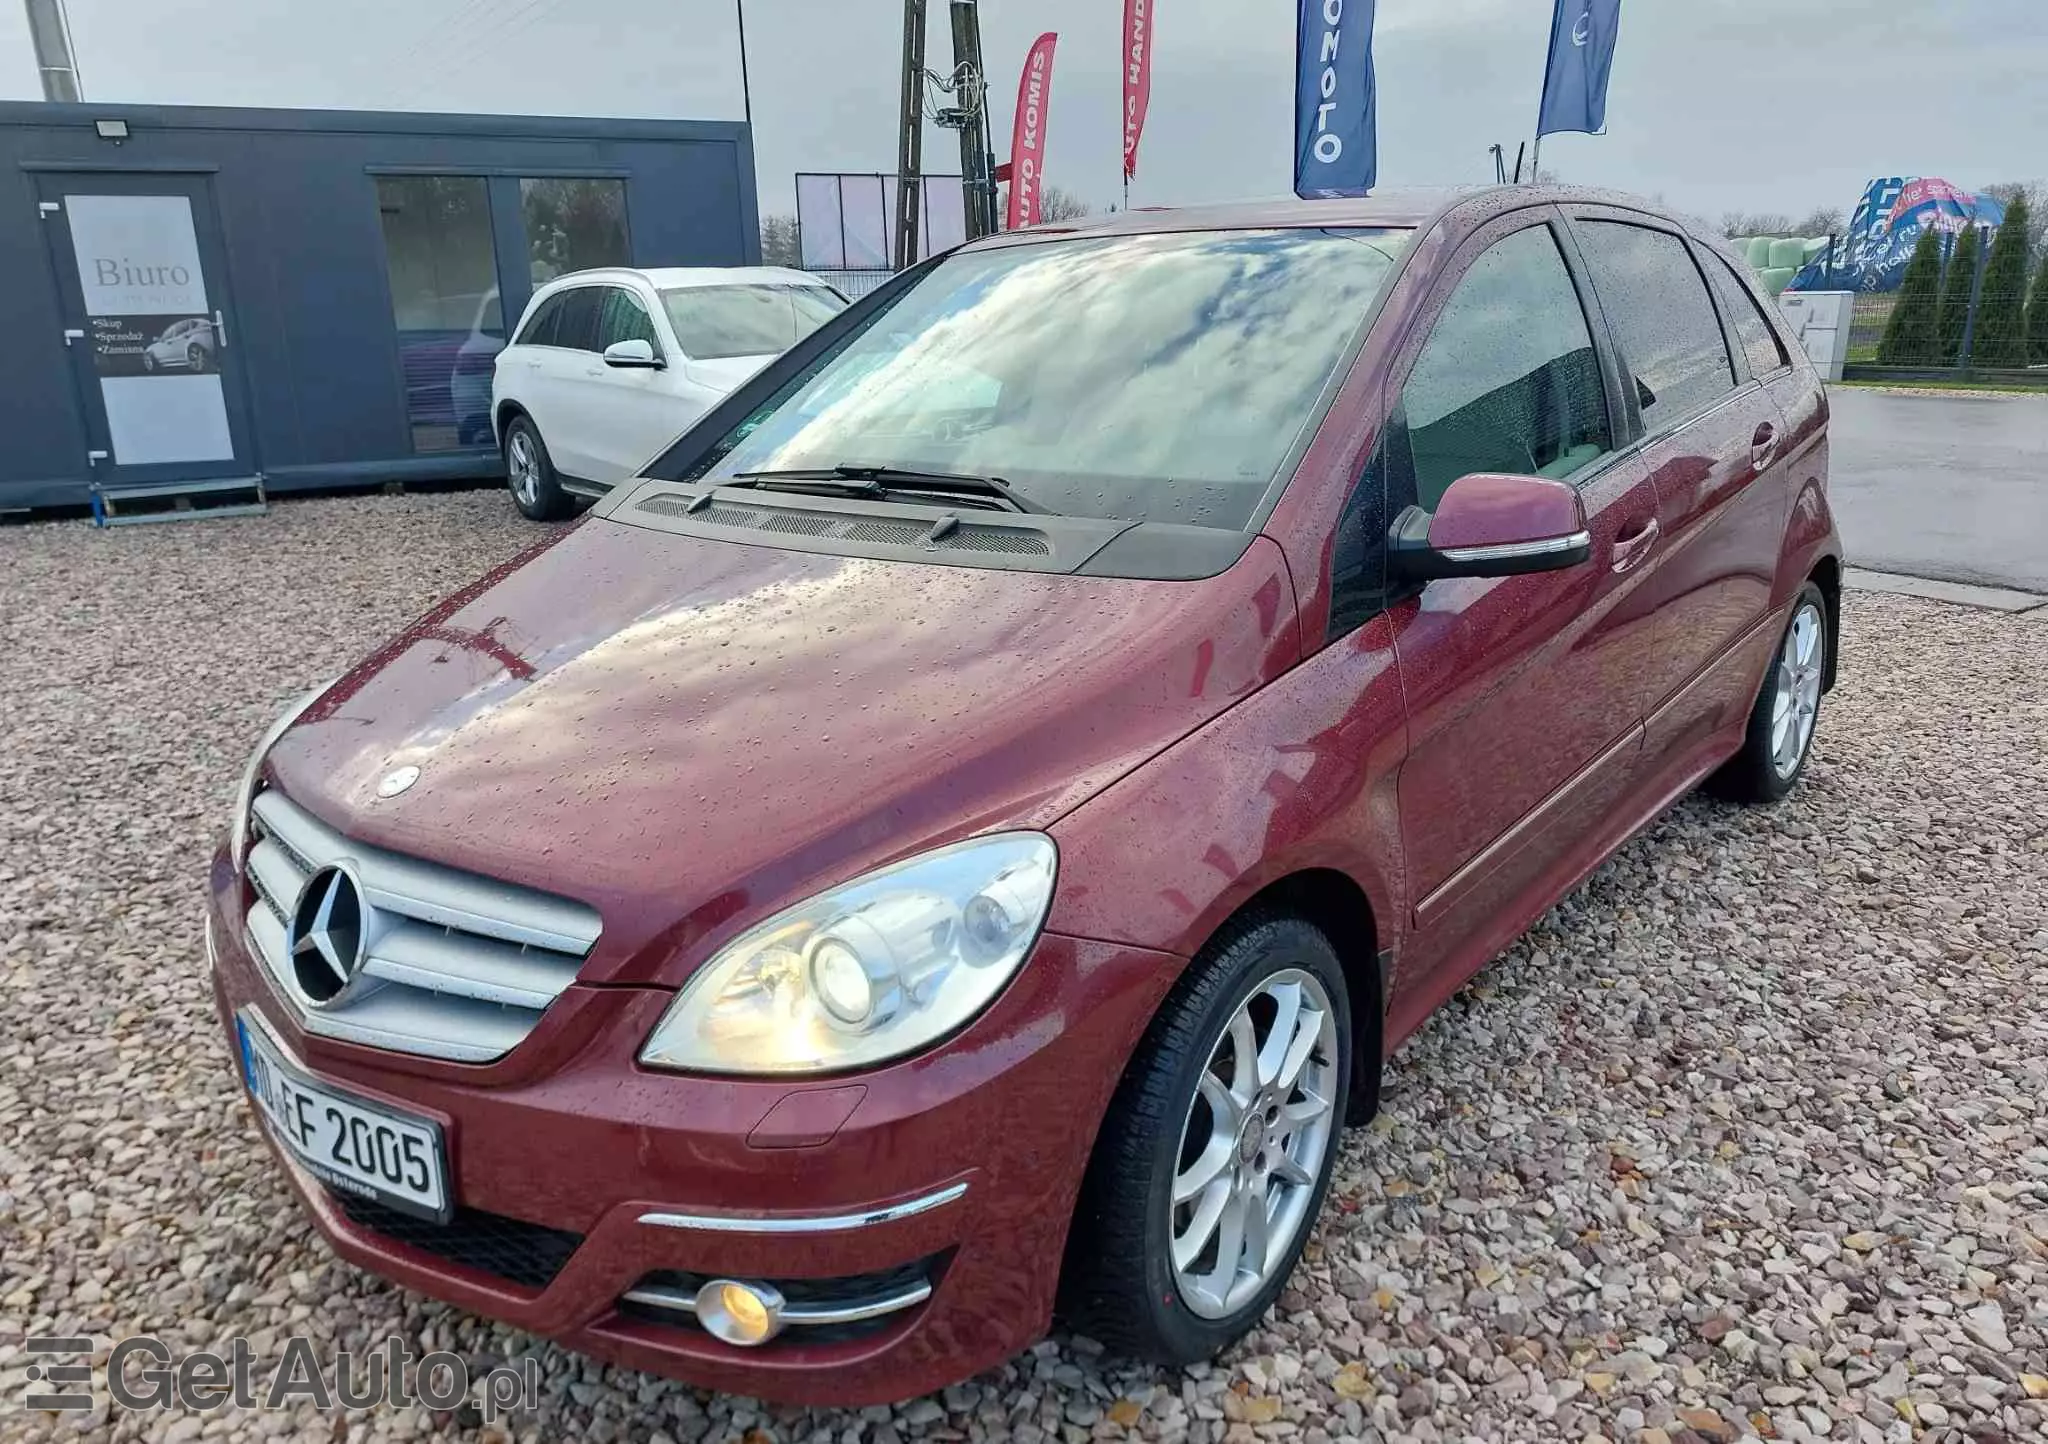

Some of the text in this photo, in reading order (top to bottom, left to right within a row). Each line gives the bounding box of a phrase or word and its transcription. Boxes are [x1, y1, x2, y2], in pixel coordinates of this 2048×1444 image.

[1023, 52, 1045, 150] KOMIS
[93, 256, 190, 287] Biuro
[326, 1107, 430, 1194] 2005
